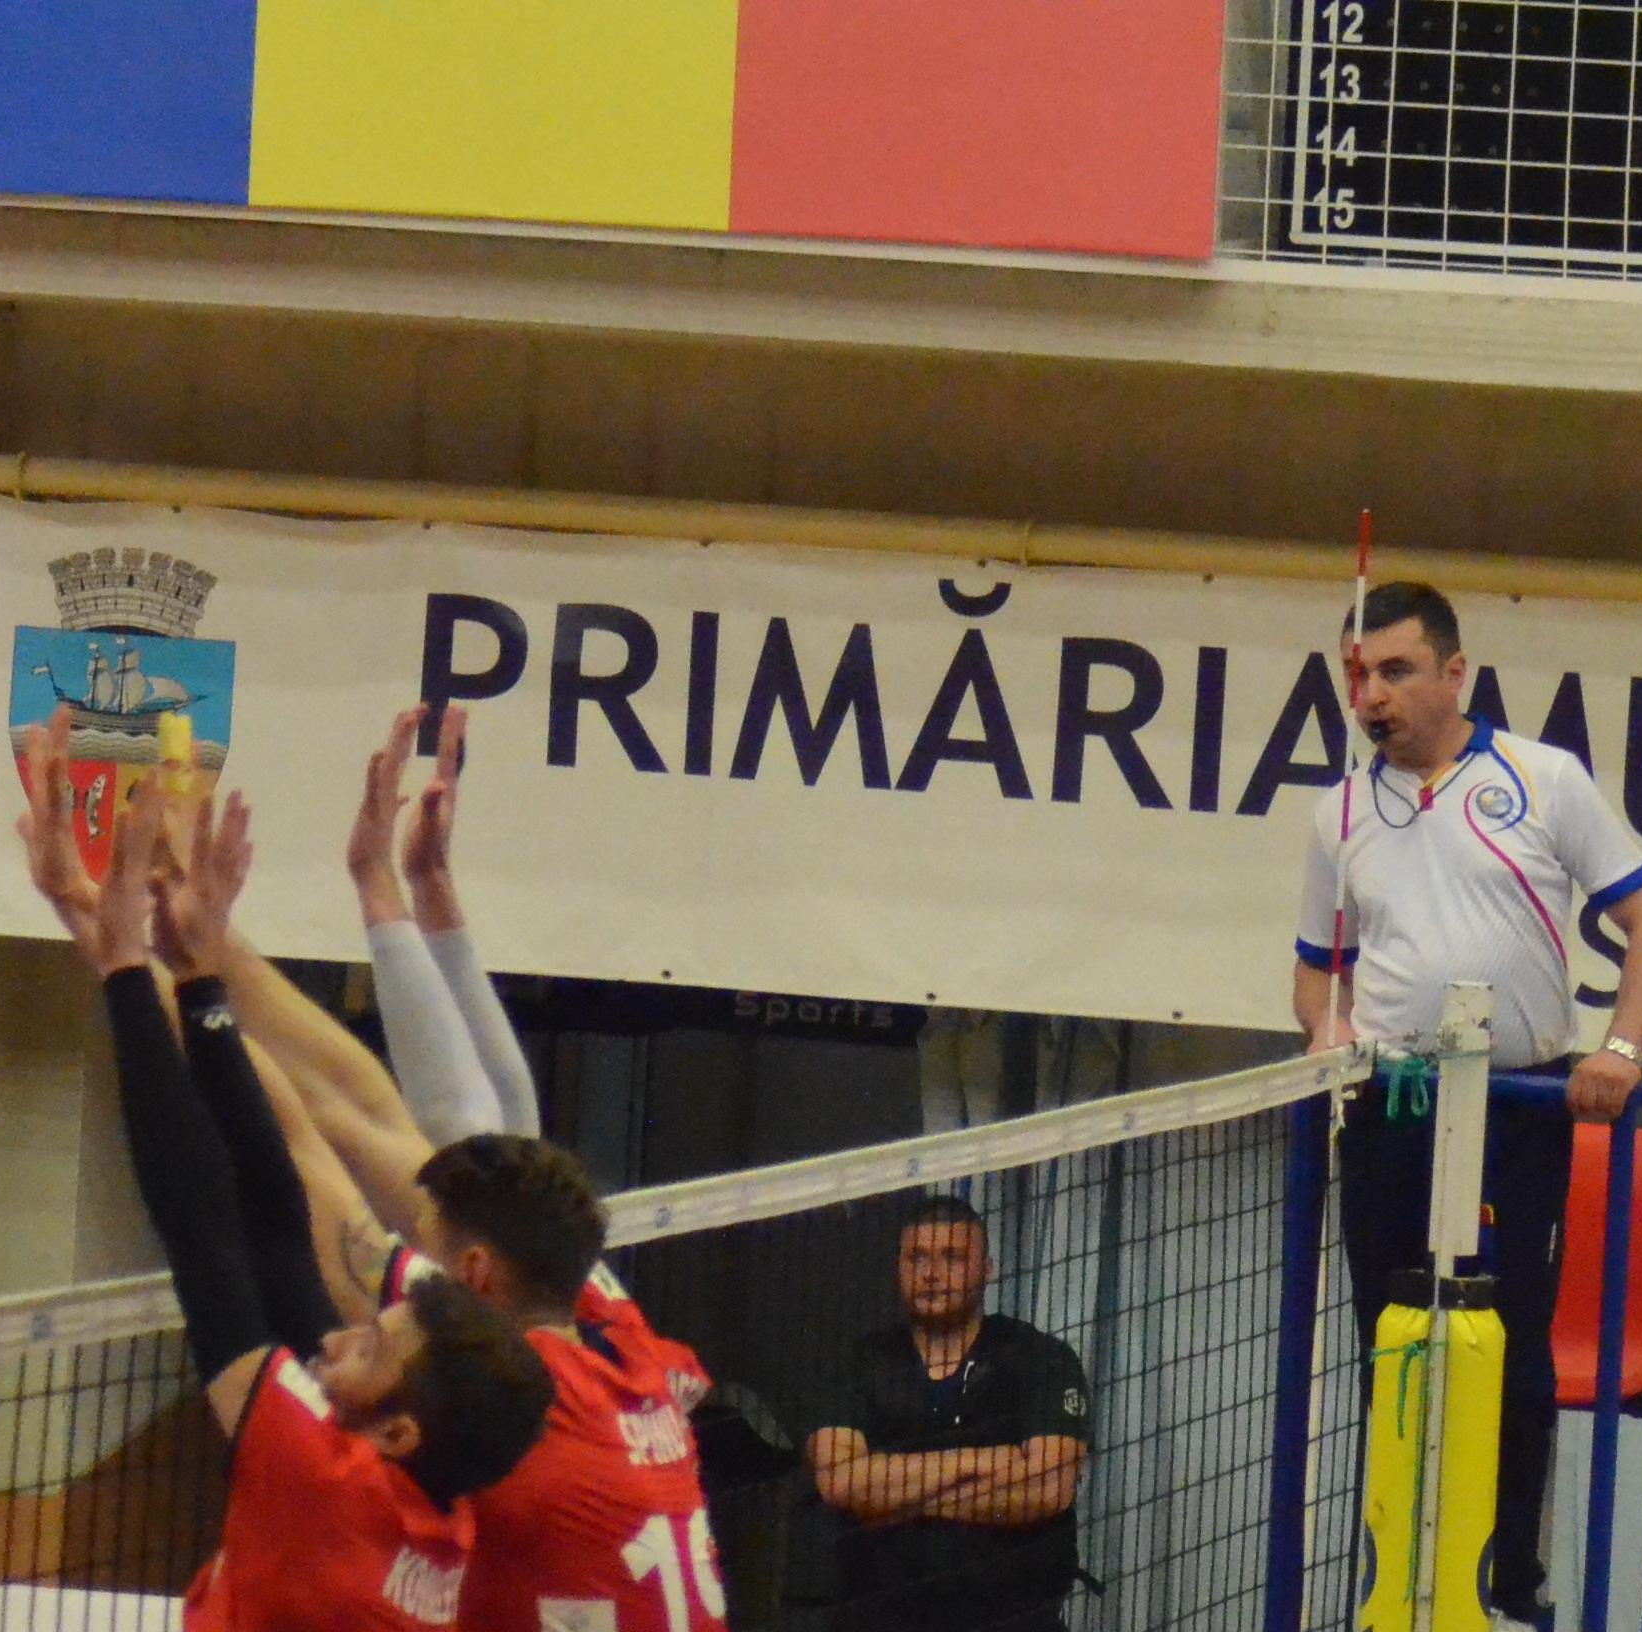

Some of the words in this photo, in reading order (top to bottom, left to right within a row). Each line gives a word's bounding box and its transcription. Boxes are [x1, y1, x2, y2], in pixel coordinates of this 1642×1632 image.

[1321, 1, 1364, 43] 12
[1319, 62, 1361, 104] 13
[1315, 125, 1356, 167] 14
[1312, 187, 1355, 229] 15
[417, 578, 1357, 816] PRIMĂRIA
